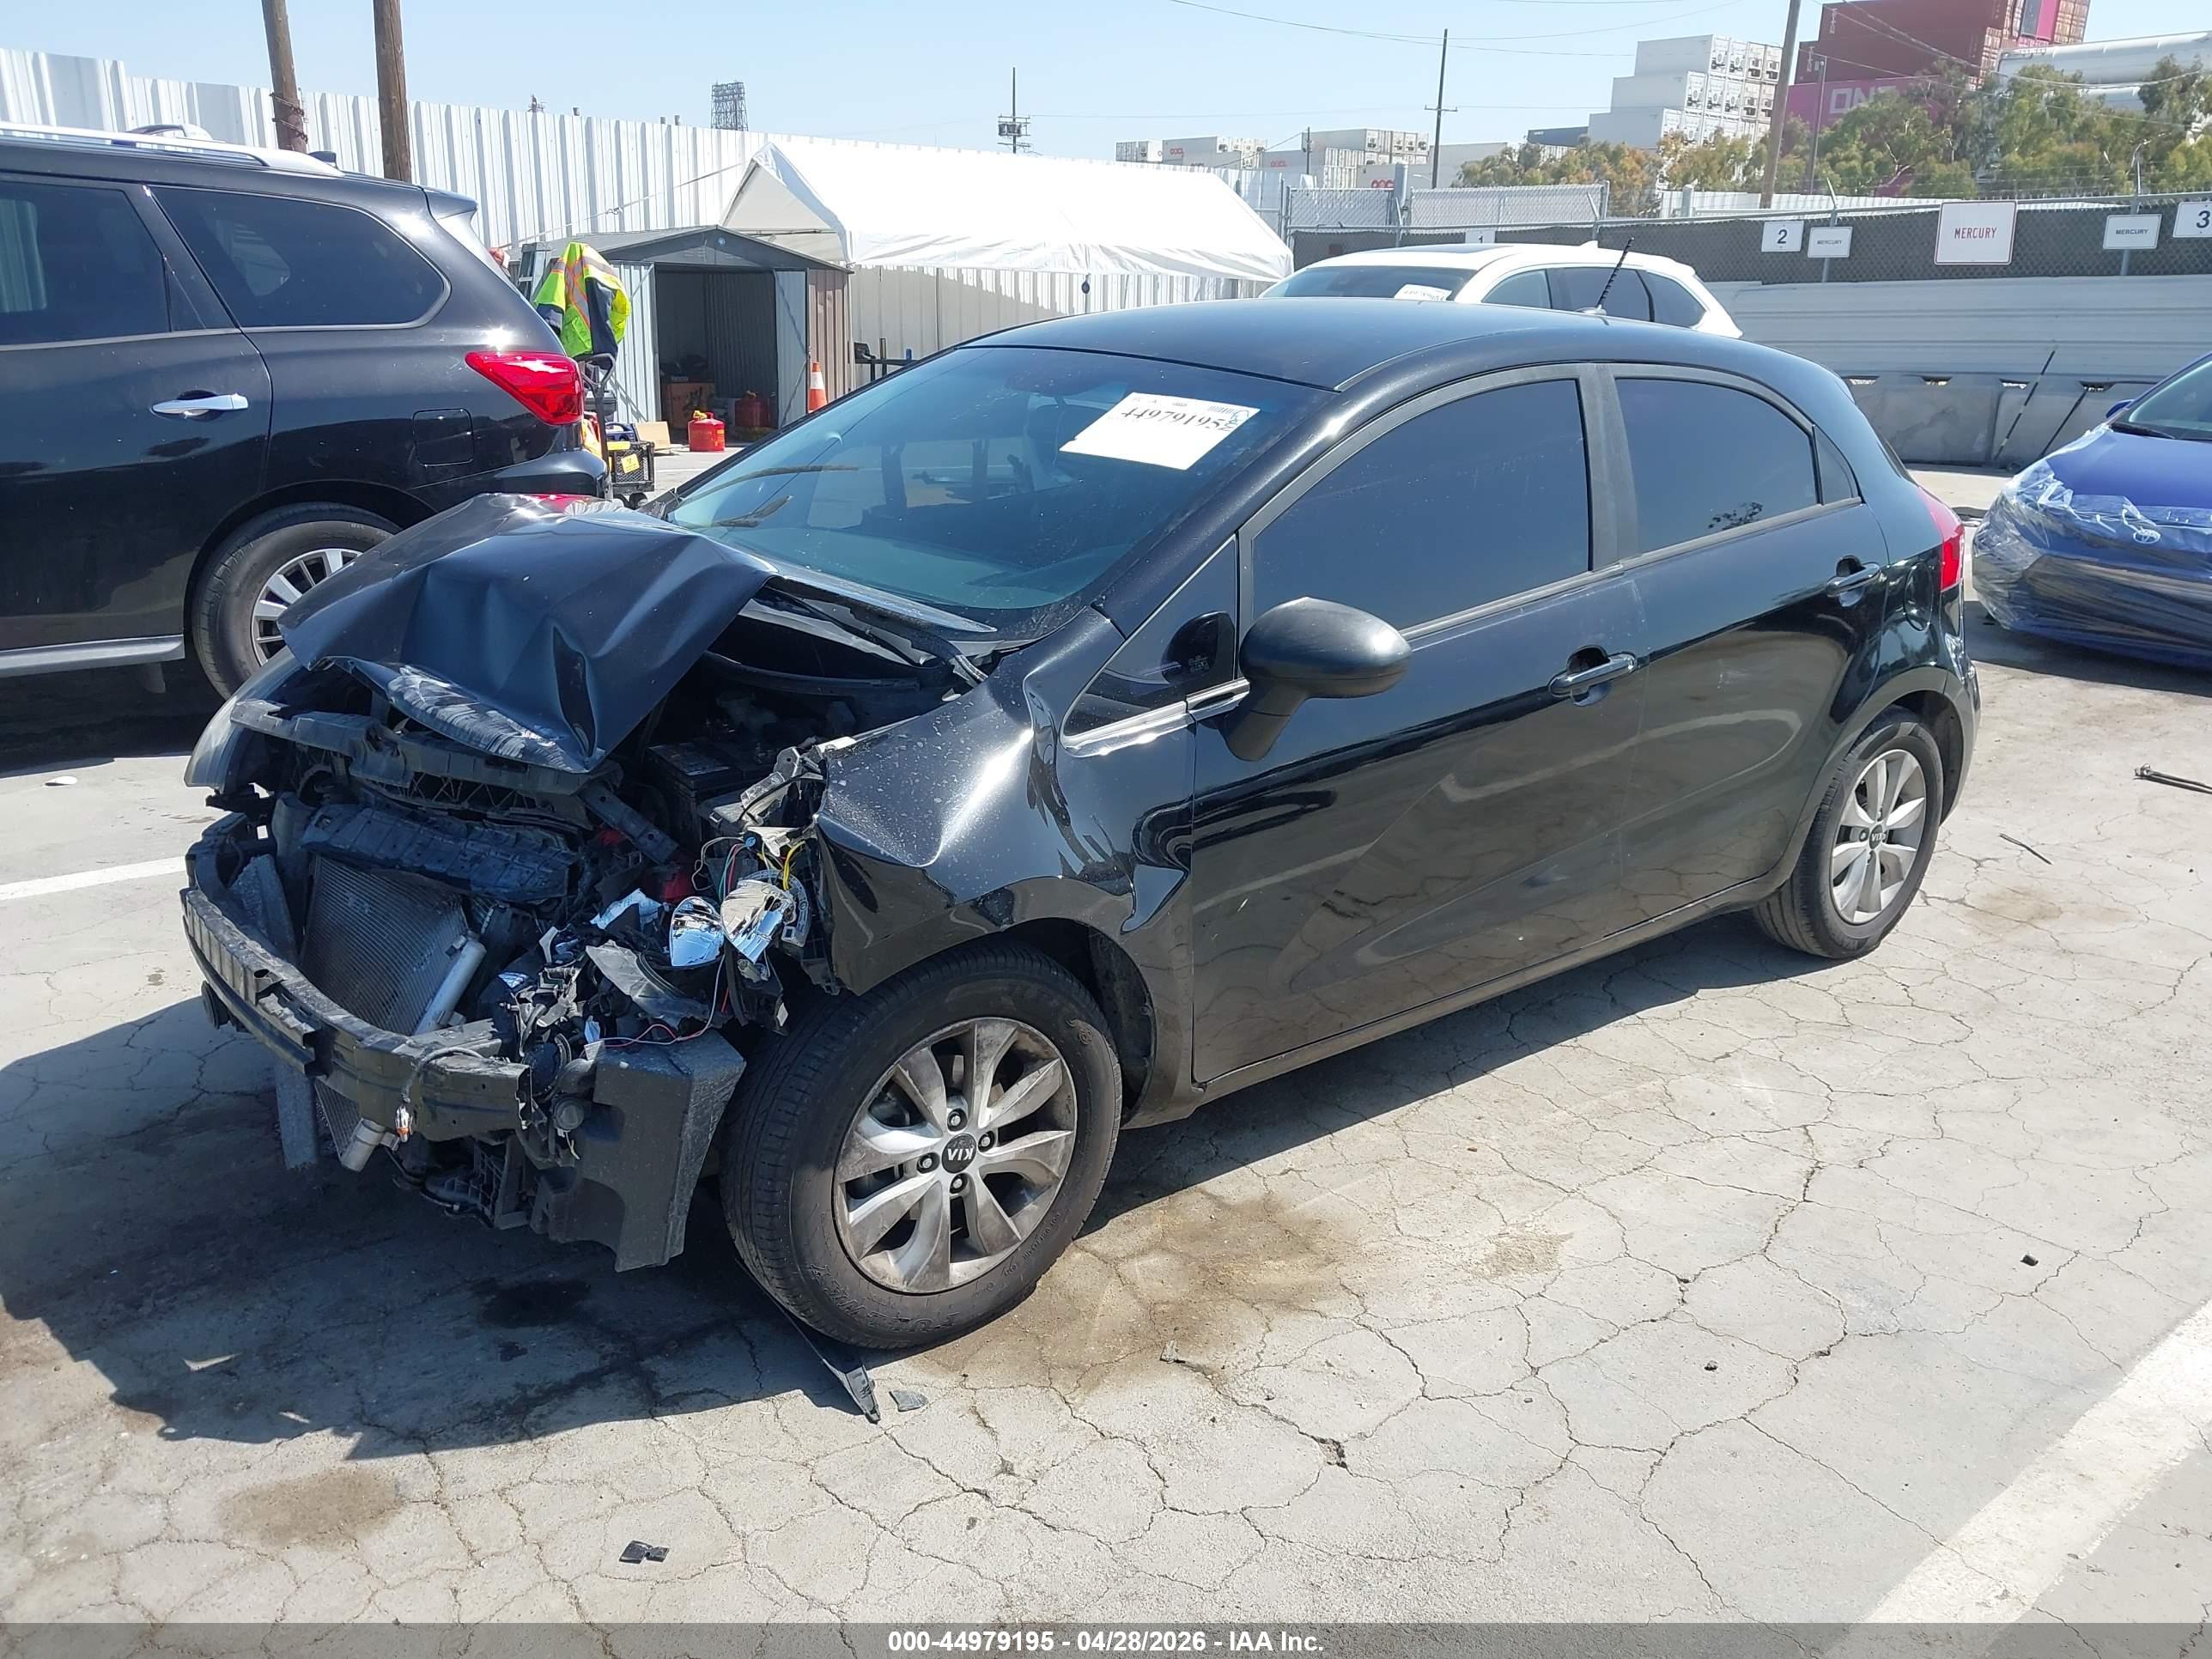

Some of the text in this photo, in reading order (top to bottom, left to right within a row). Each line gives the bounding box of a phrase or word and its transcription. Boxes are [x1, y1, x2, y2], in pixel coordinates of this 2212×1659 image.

[1829, 85, 1896, 113] ON
[2196, 210, 2210, 228] 3
[1777, 228, 1788, 244] 2
[1954, 228, 1997, 239] MERCURY
[1121, 407, 1224, 429] 44979195
[947, 1146, 974, 1161] KIA
